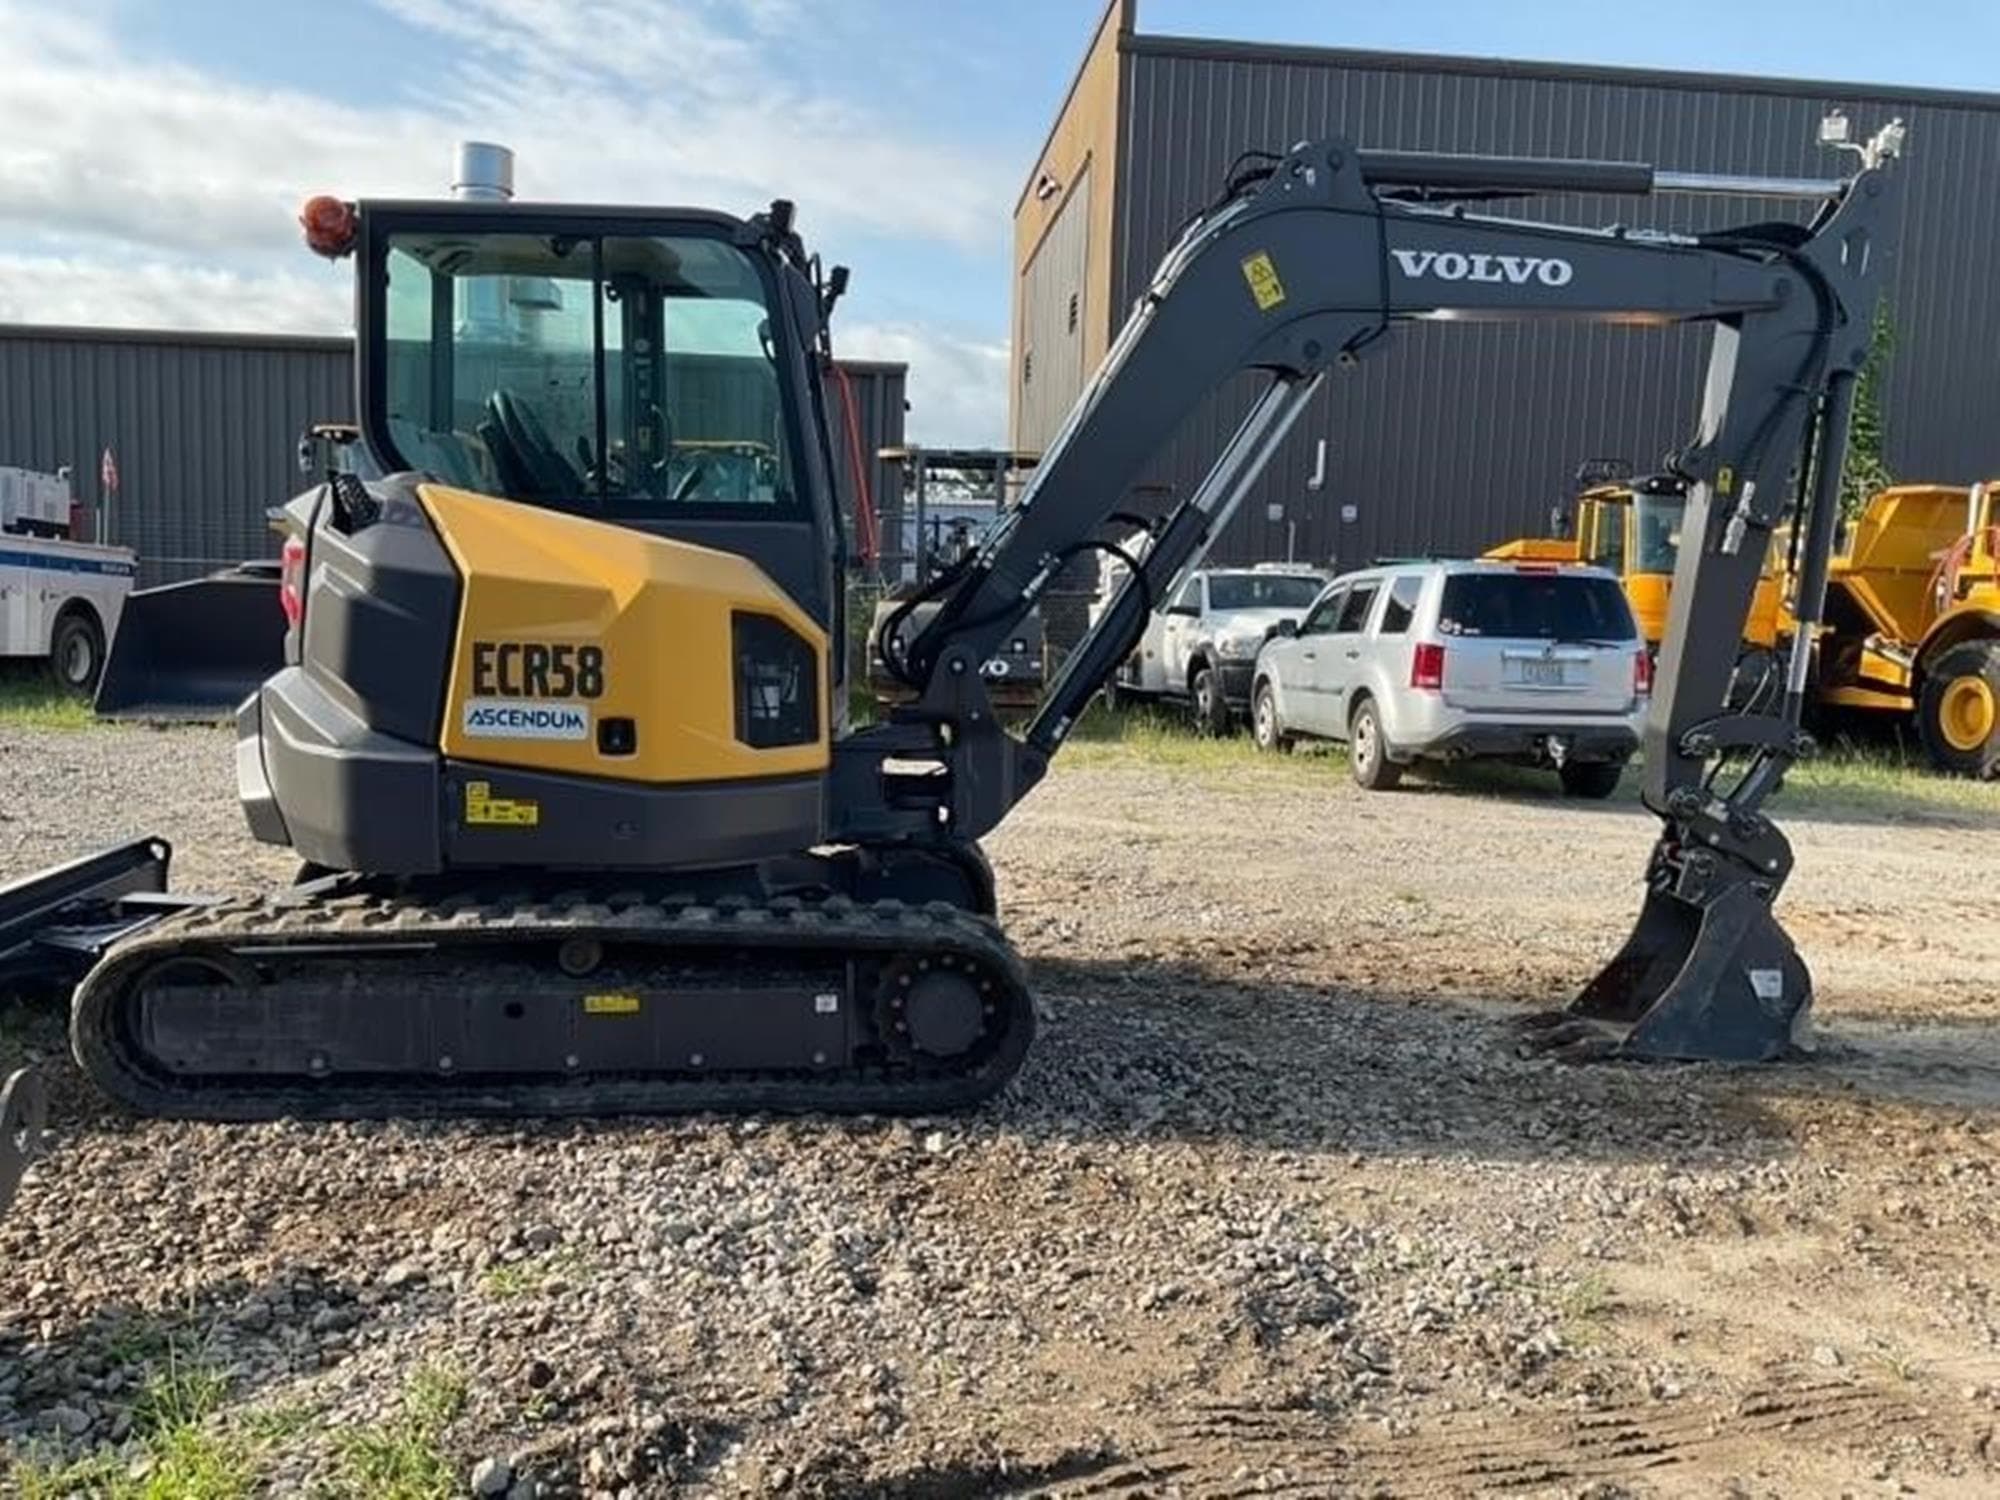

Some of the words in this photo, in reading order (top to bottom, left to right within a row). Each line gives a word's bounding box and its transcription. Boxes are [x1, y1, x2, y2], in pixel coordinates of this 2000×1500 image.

[1390, 249, 1573, 286] VOLVO
[473, 642, 604, 698] ECR58
[467, 708, 584, 729] ASCENDUM
